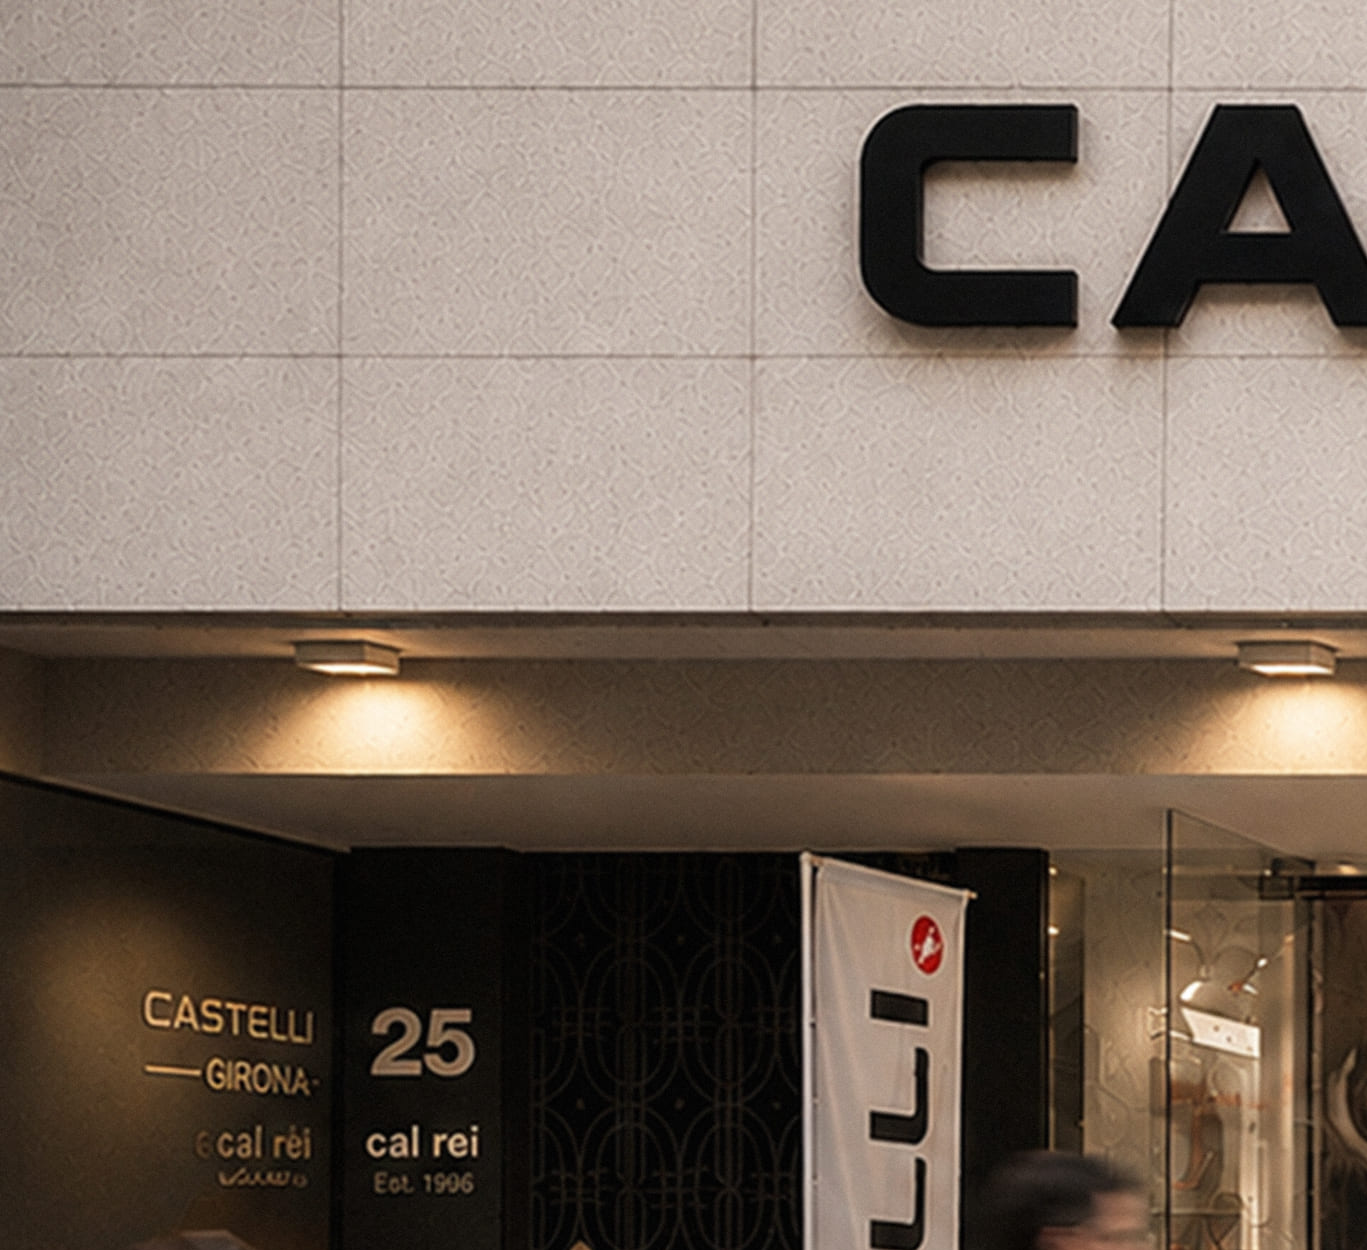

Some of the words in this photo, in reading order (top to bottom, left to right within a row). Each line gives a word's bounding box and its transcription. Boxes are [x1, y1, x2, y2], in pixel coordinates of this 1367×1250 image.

[144, 990, 313, 1043] CASTELLI
[370, 1006, 475, 1077] 25
[206, 1056, 311, 1096] GIRONA
[216, 1124, 262, 1159] cal
[366, 1124, 419, 1158] cal
[433, 1124, 479, 1158] rei
